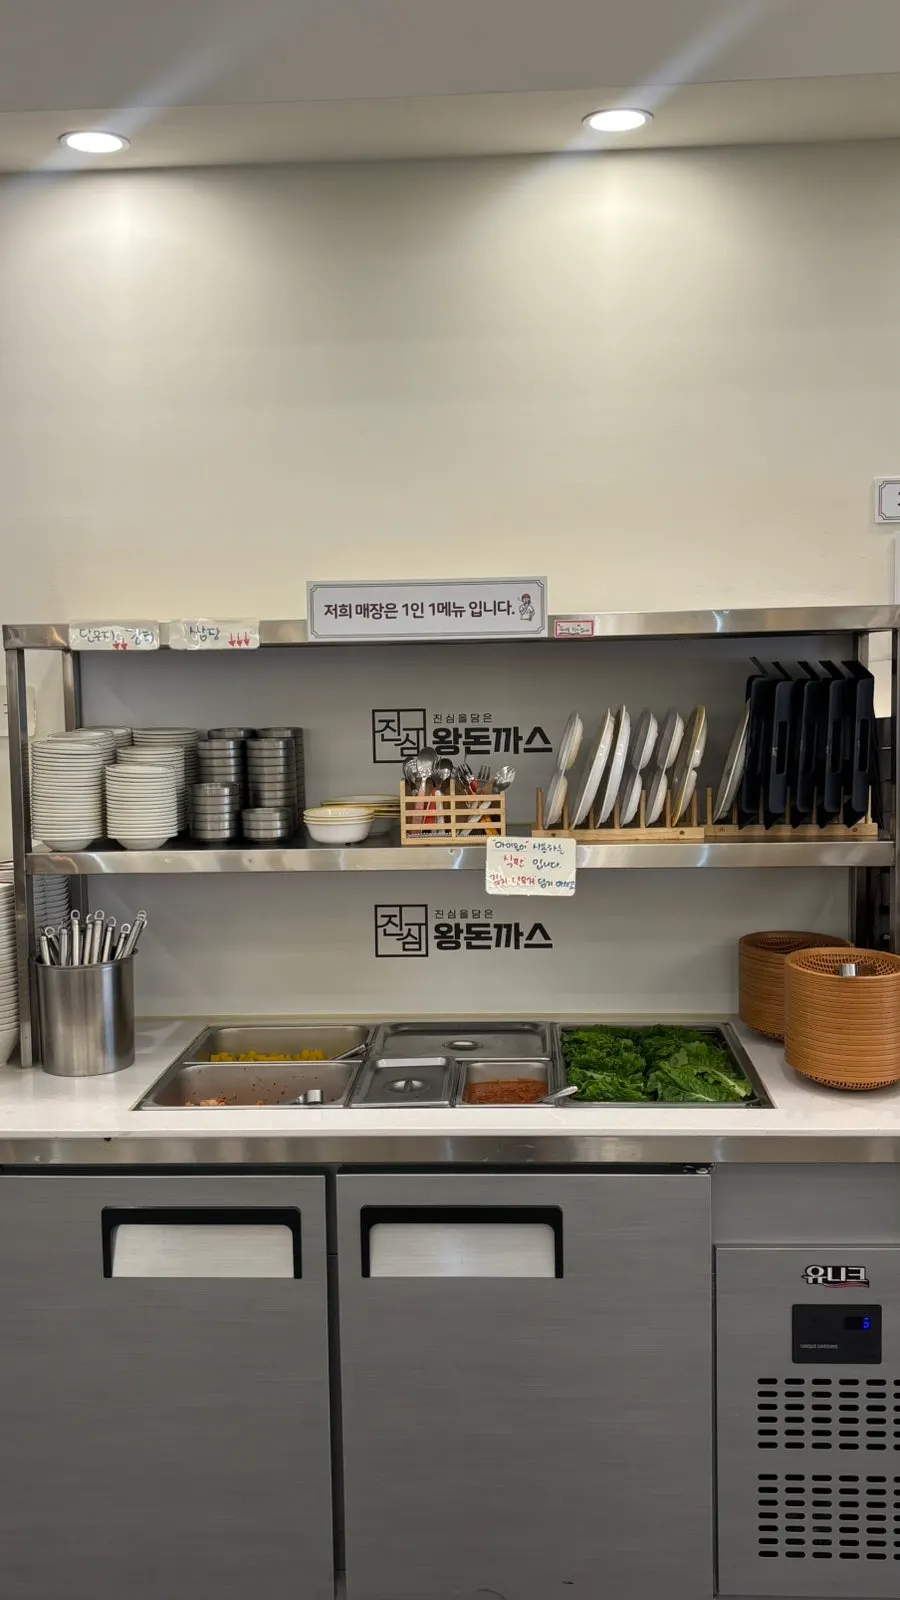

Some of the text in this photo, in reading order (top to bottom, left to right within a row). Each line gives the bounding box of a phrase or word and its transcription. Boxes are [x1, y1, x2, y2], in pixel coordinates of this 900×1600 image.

[323, 600, 516, 620] 저희 매장은 1인 1메뉴 입니다.
[432, 726, 553, 756] 왕돈까스
[433, 922, 553, 951] 왕돈까스
[802, 1264, 868, 1285] 유니크
